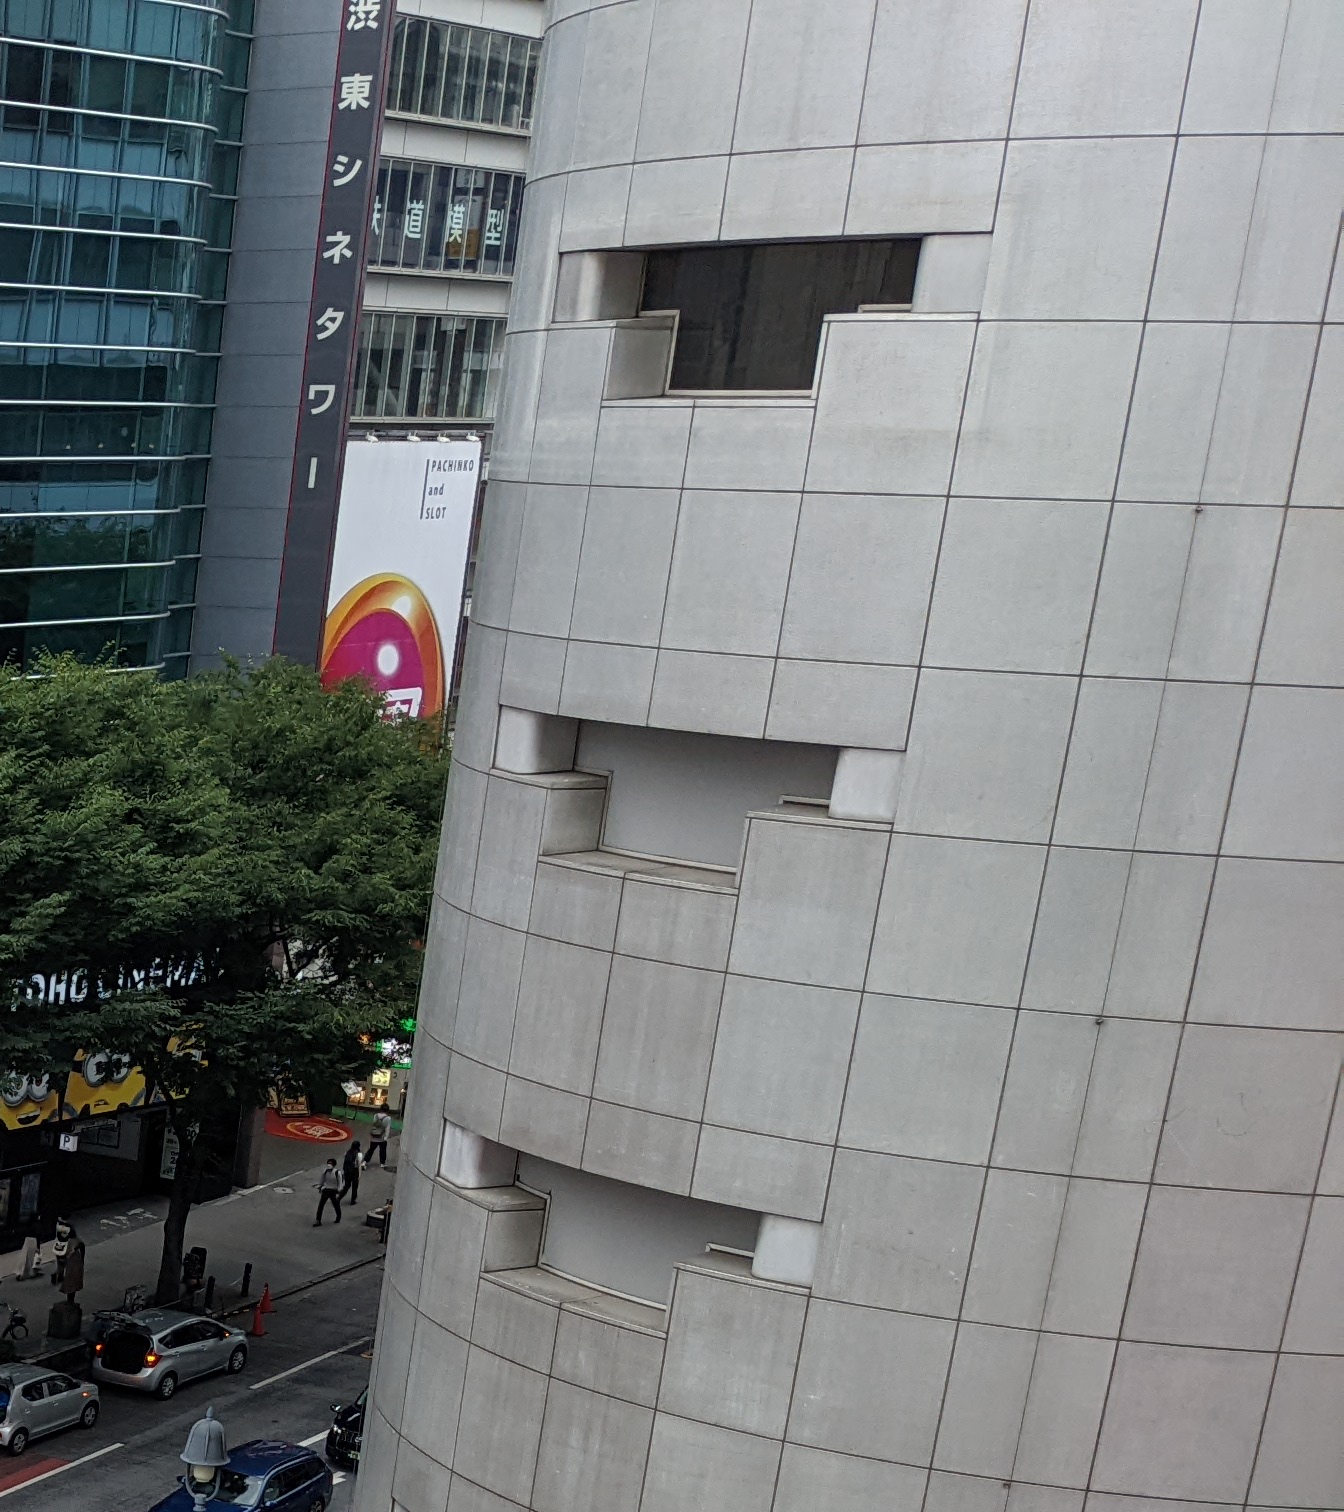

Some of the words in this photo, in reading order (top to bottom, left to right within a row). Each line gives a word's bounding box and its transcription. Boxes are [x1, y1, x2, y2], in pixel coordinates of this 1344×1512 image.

[307, 0, 380, 490] 渋東シネタワー
[431, 459, 475, 473] PACHINKO
[428, 483, 445, 497] and
[425, 506, 447, 520] SLOT
